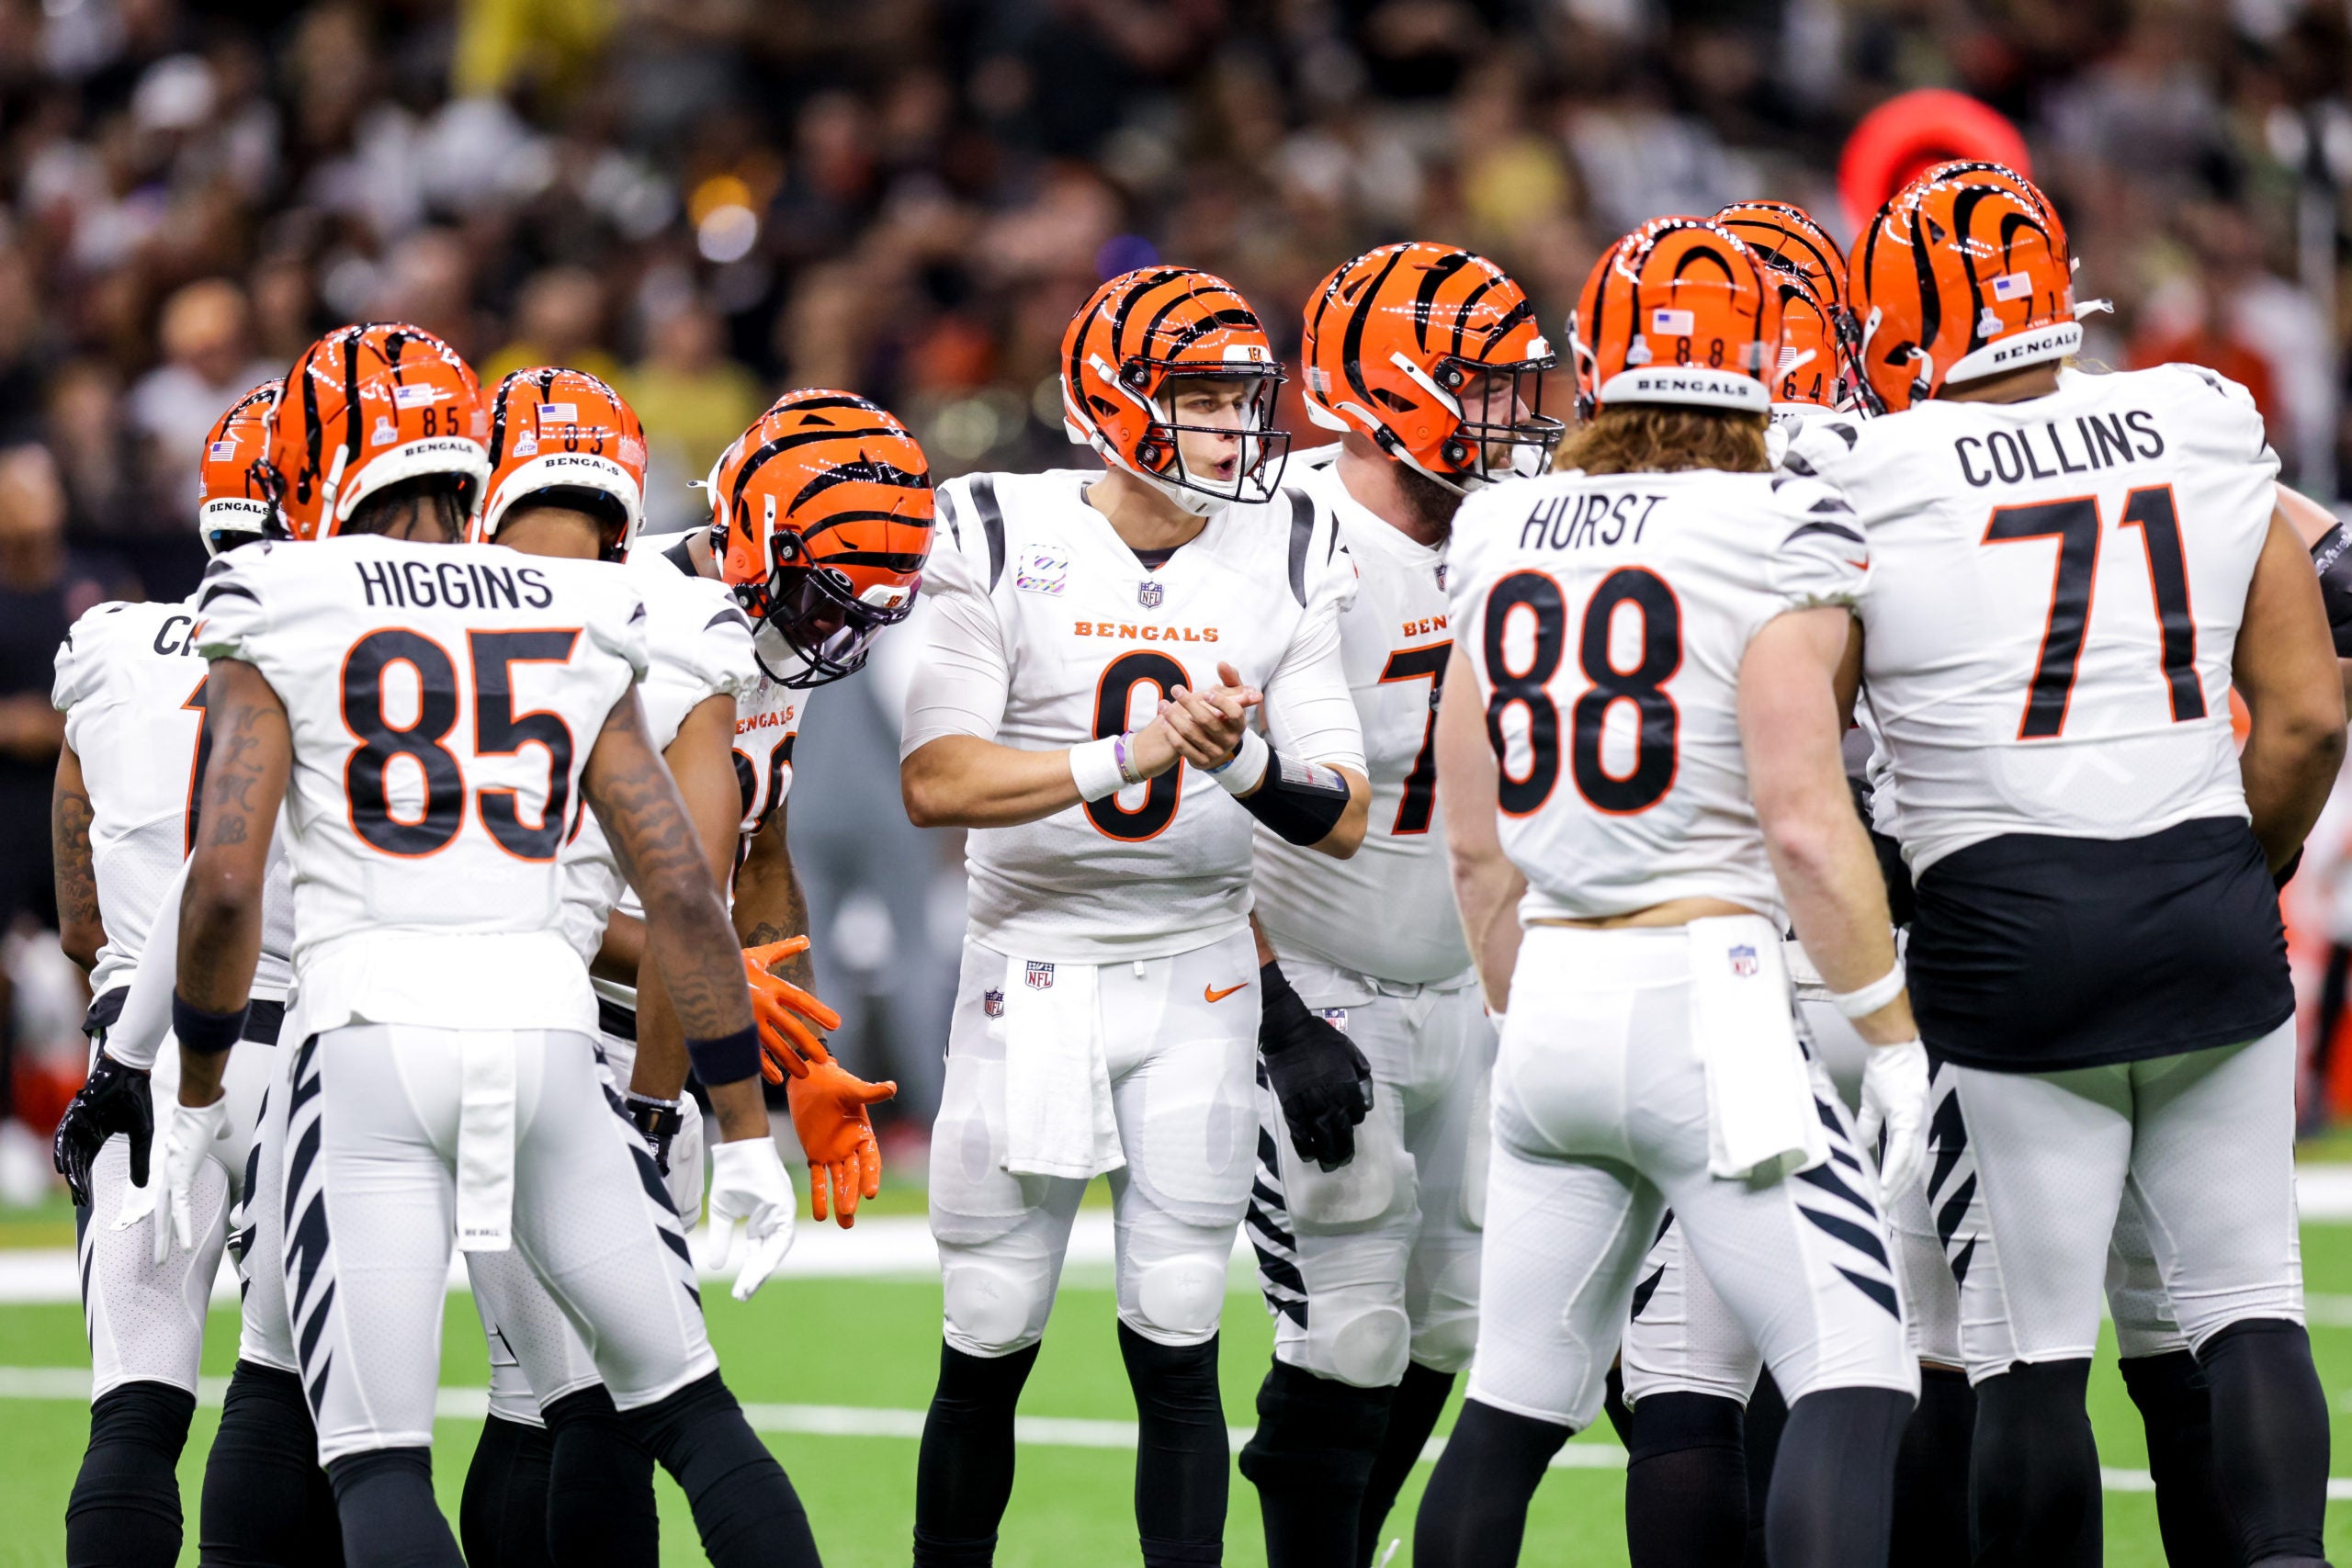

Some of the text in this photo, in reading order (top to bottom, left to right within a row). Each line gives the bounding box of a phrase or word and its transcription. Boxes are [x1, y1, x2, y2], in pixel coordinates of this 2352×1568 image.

[2020, 291, 2055, 327] 71
[1675, 336, 1724, 367] 88
[1994, 332, 2078, 363] BENGALS
[1636, 379, 1748, 397] BENGALS
[1782, 371, 1822, 403] 64
[423, 407, 459, 437] 85
[404, 437, 473, 457] BENGALS
[1954, 410, 2165, 488] COLLINS
[1519, 493, 1668, 551] HURST
[355, 560, 553, 609] HIGGINS
[1141, 591, 1160, 606] NFL
[1402, 615, 1448, 637] BEN
[1980, 483, 2208, 740] 71
[1074, 621, 1219, 642] BENGALS
[1484, 563, 1683, 819] 88
[735, 704, 795, 735] ENGALS
[339, 626, 583, 863] 85
[1028, 971, 1051, 987] NFL
[986, 1000, 1001, 1014] NFL
